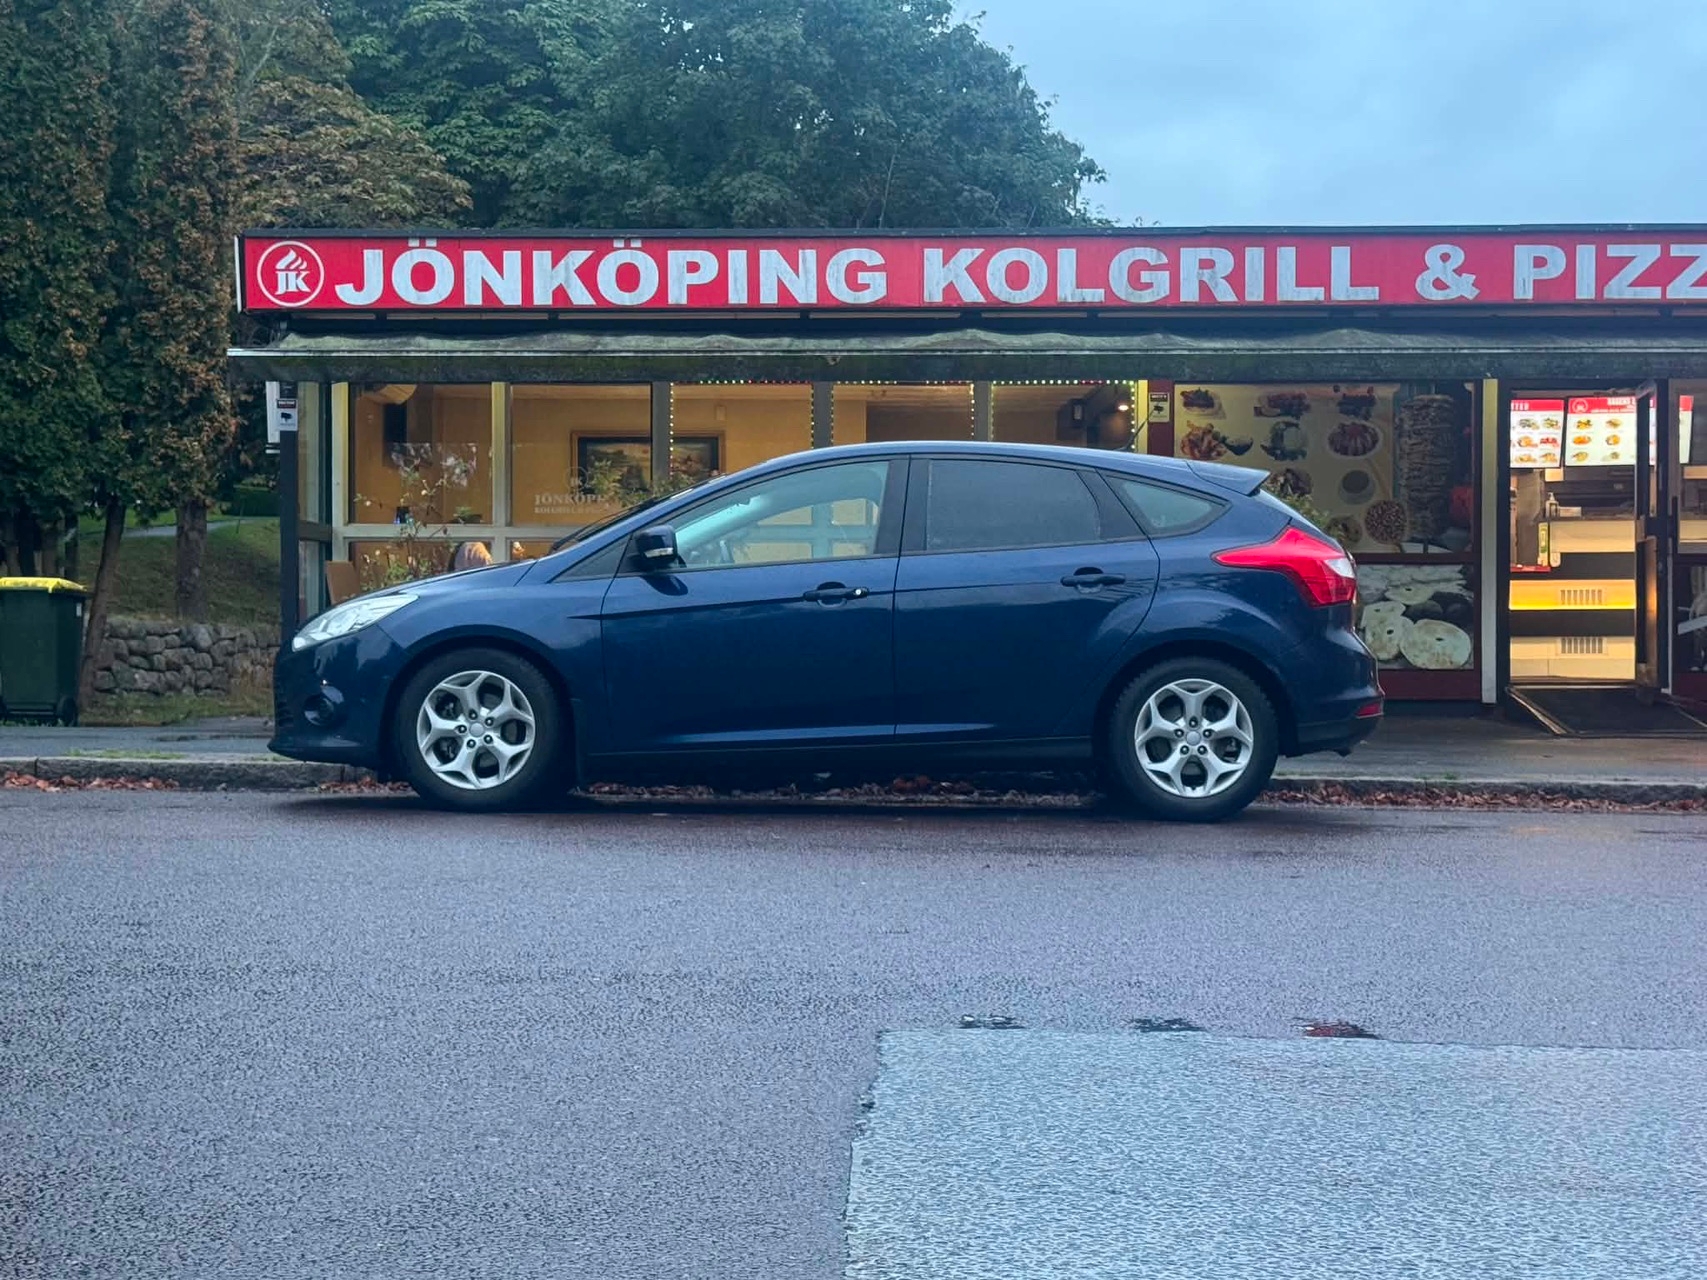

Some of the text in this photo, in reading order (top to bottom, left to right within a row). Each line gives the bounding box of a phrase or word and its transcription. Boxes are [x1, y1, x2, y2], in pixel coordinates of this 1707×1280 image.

[335, 238, 1707, 305] JÖNKÖPING KOLGRILL & PIZZ
